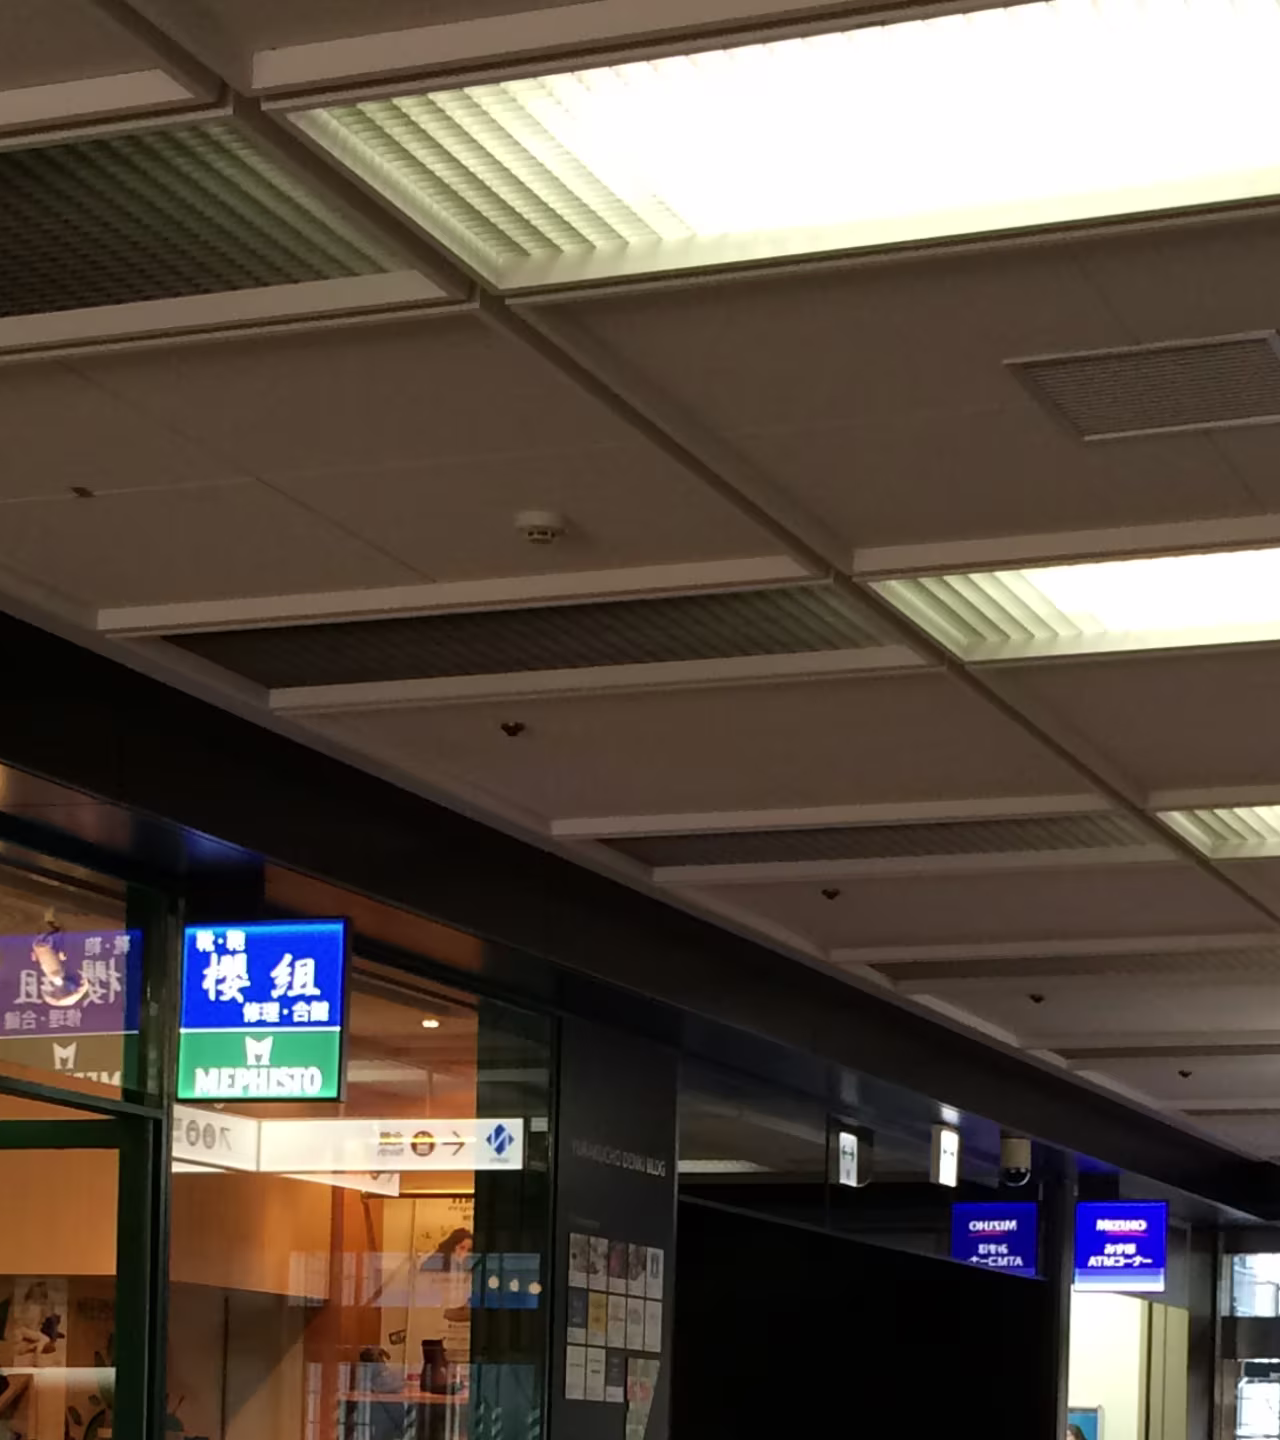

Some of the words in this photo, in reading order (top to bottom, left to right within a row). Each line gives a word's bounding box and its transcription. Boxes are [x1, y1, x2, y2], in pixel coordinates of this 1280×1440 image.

[194, 1066, 323, 1098] MEPHISTO
[1095, 1219, 1148, 1232] MIZUHO
[1087, 1255, 1153, 1267] ATMコーナー
